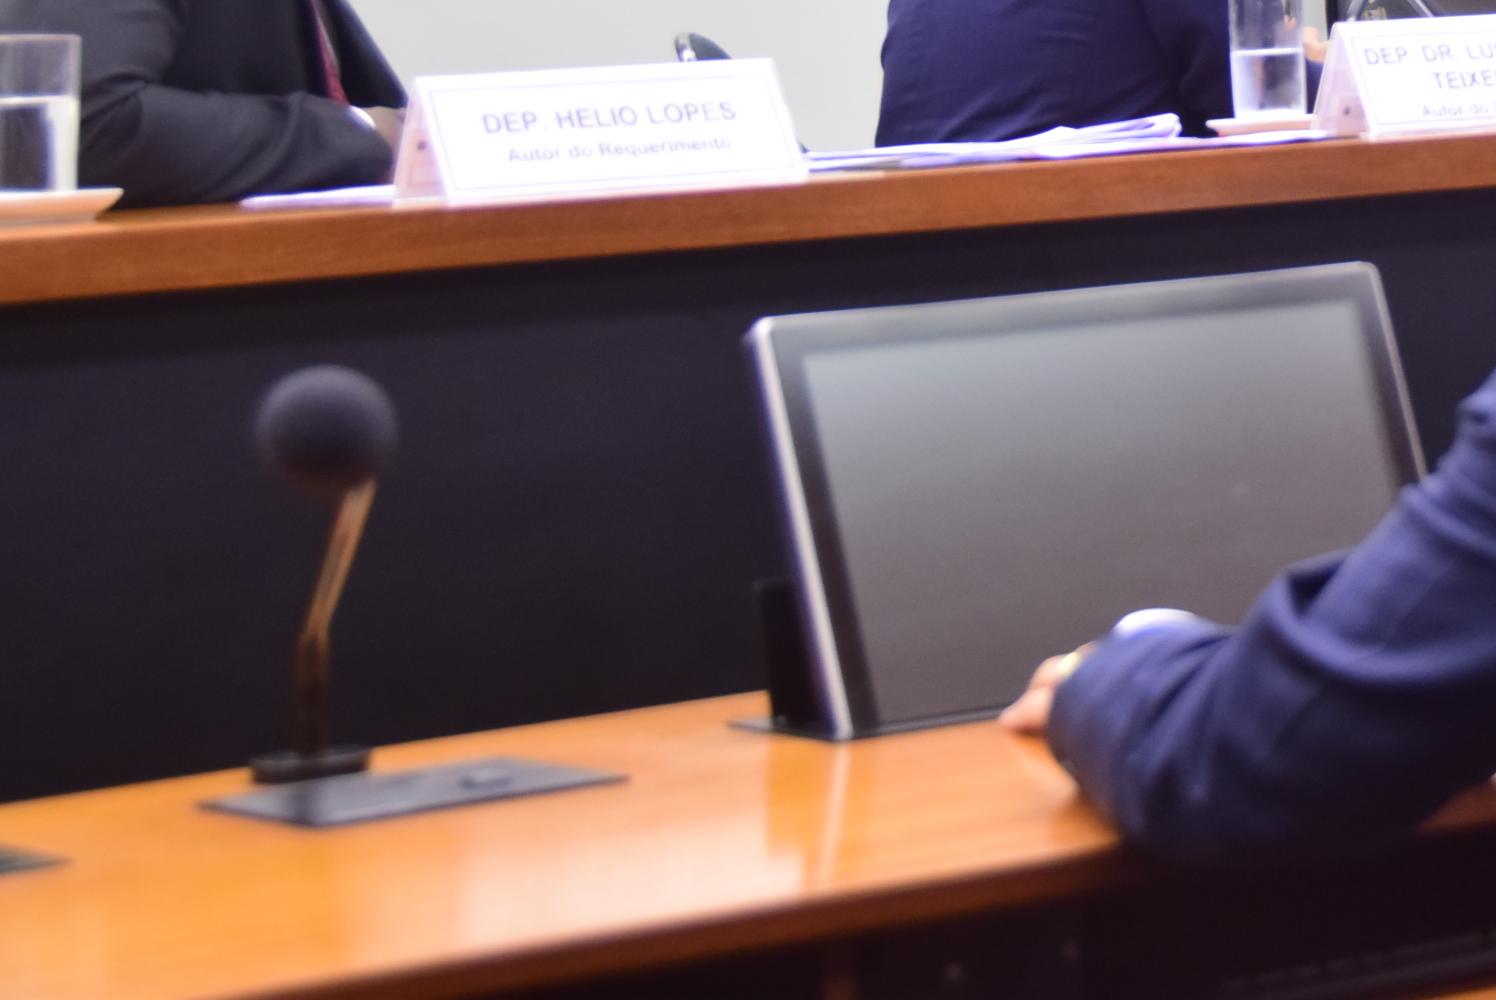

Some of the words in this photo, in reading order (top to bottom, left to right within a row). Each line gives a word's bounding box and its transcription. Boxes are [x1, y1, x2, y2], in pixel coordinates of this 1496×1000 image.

[481, 110, 548, 135] DEP.
[555, 106, 638, 129] HELIO
[646, 101, 737, 125] LOPES
[1422, 103, 1464, 118] Autor
[1469, 103, 1489, 115] do
[508, 148, 560, 162] Autor
[568, 145, 593, 158] do
[598, 138, 732, 157] Requerimento
